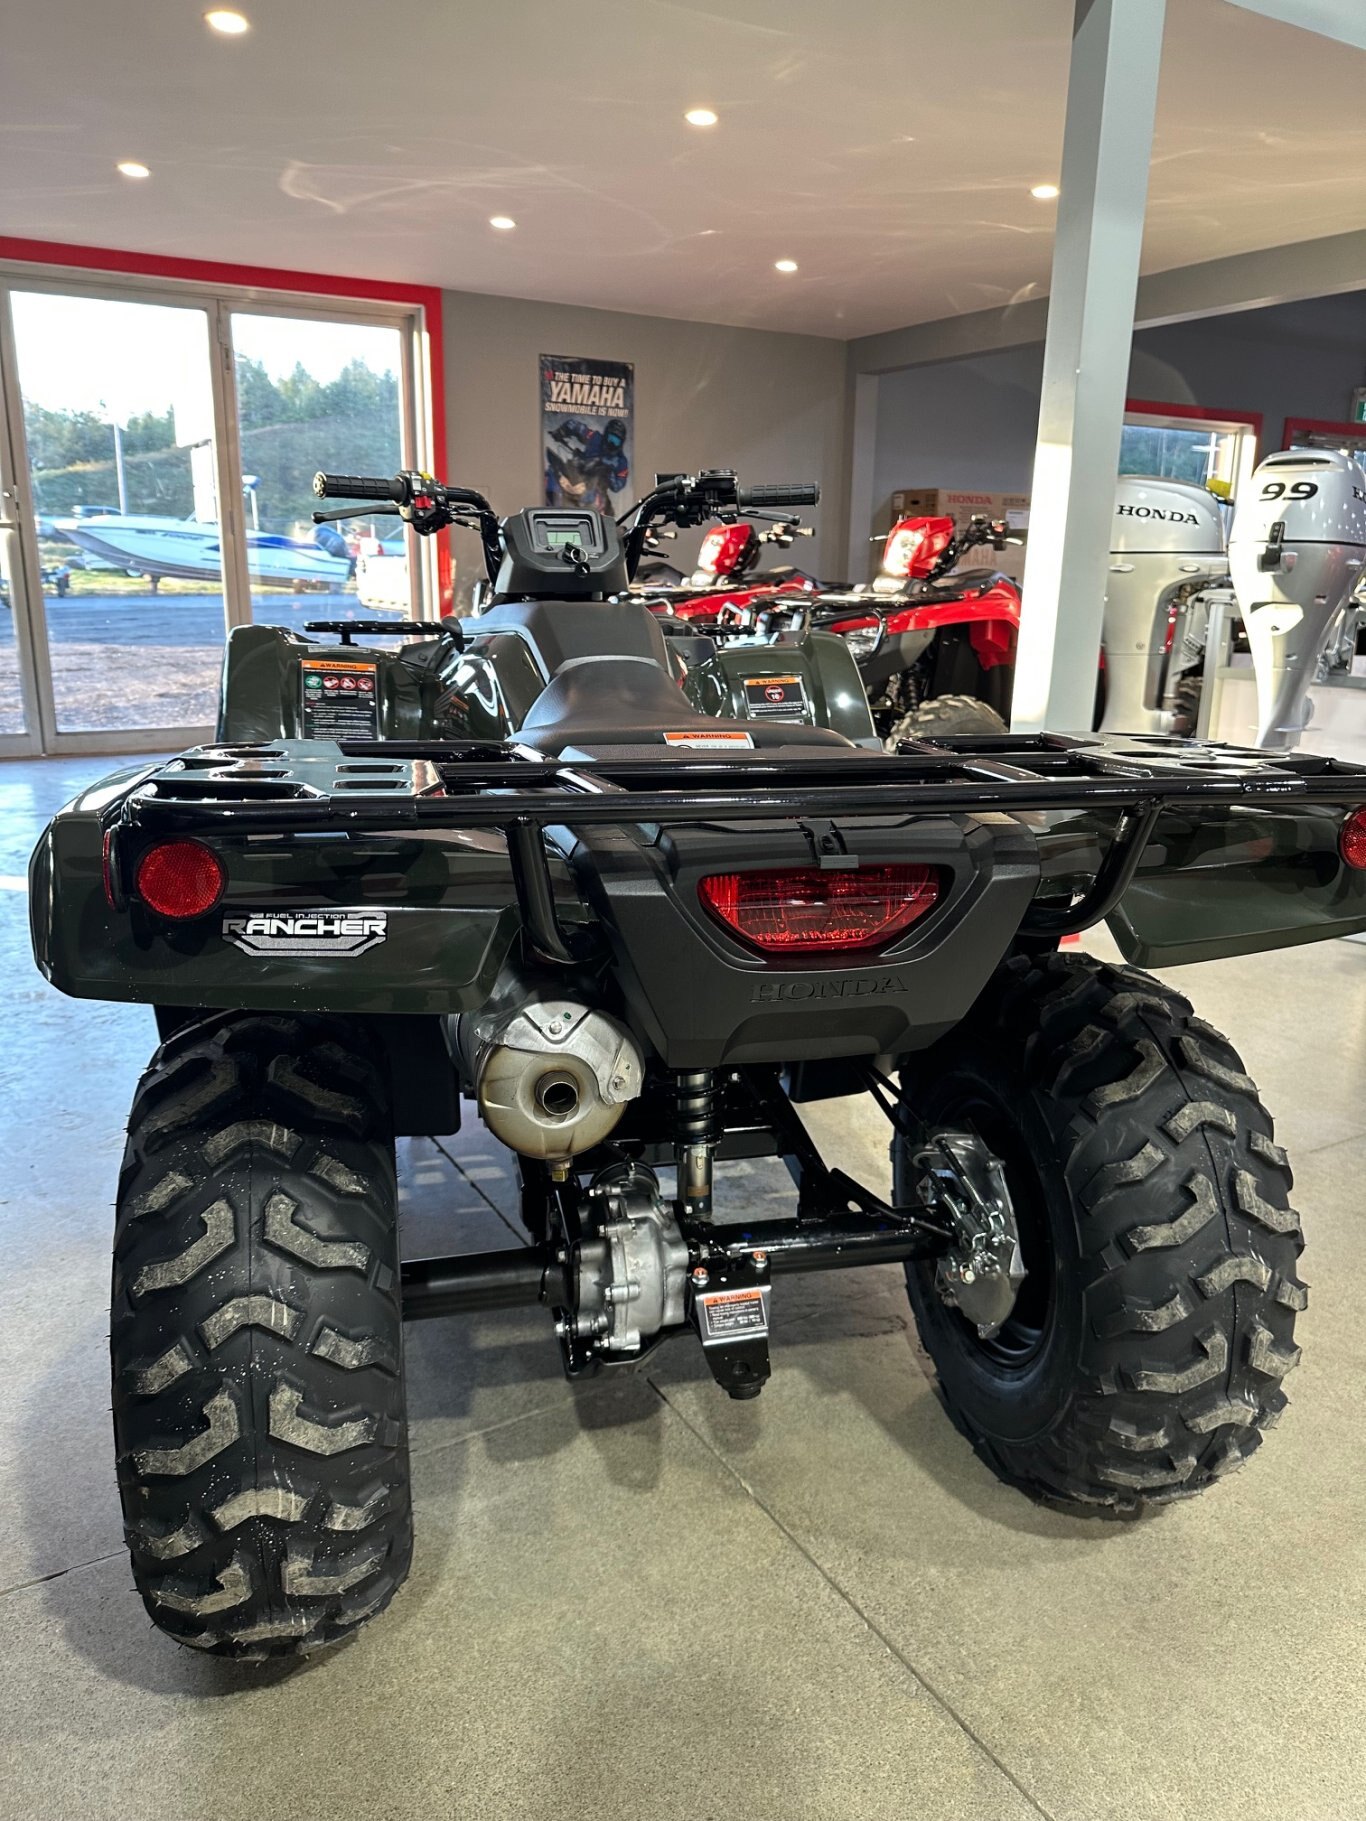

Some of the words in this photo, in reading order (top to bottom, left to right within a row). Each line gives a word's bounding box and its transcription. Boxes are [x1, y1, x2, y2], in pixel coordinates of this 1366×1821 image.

[555, 372, 570, 382] THE
[571, 373, 591, 384] TIME
[592, 375, 602, 385] TO
[603, 376, 619, 386] BUY
[619, 378, 626, 387] A
[550, 381, 624, 408] YAMAHA
[545, 402, 598, 416] SNOWMOBILE
[598, 407, 607, 416] IS
[947, 495, 993, 505] HONDA
[1116, 505, 1200, 525] HONDA
[222, 919, 387, 936] RANCHER
[749, 975, 909, 1003] HONDA
[719, 1293, 752, 1302] WARNING
